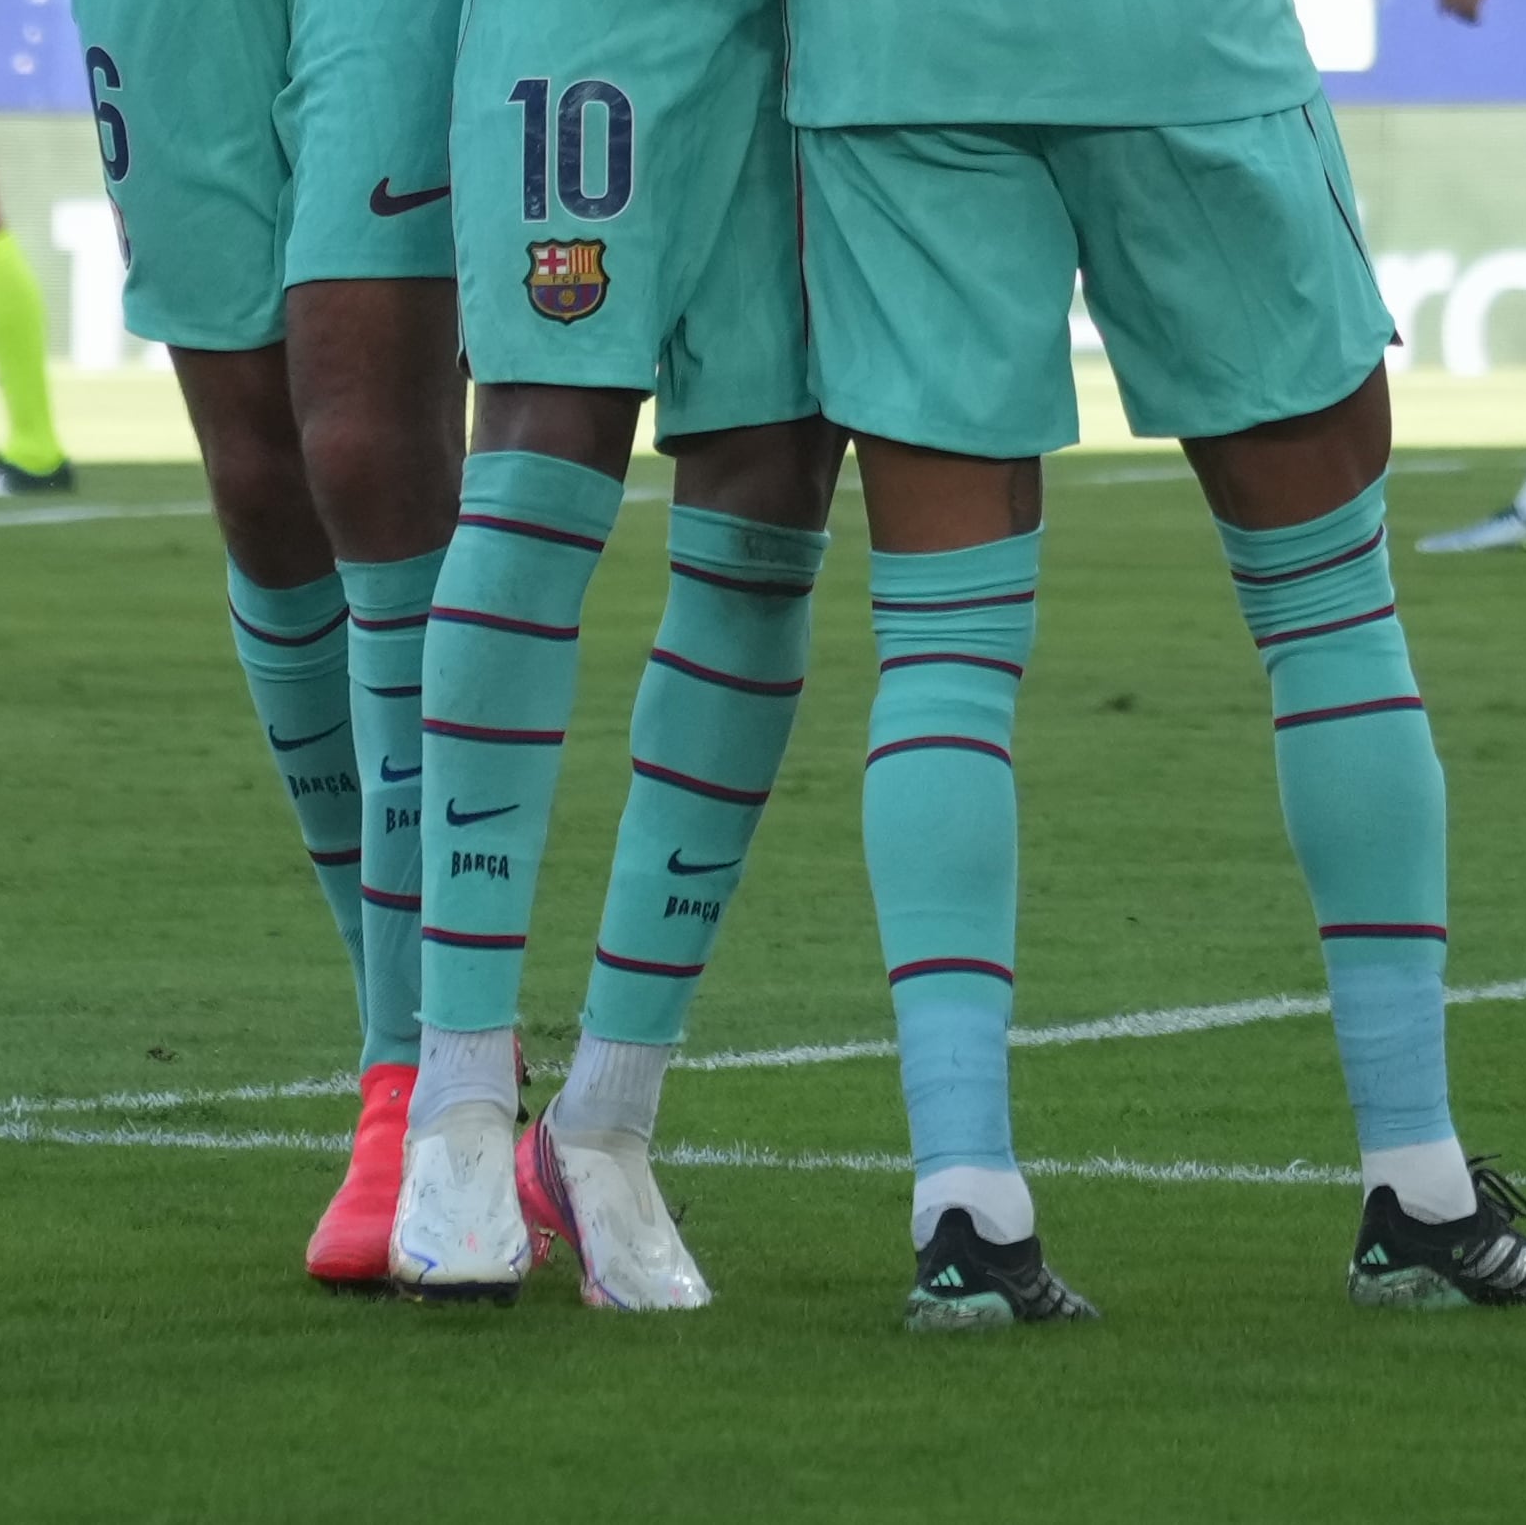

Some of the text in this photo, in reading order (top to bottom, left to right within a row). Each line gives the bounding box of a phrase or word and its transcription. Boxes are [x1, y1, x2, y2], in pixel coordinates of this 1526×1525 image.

[505, 78, 635, 223] 10
[451, 850, 510, 880] BARÇA
[664, 895, 721, 923] BARÇA
